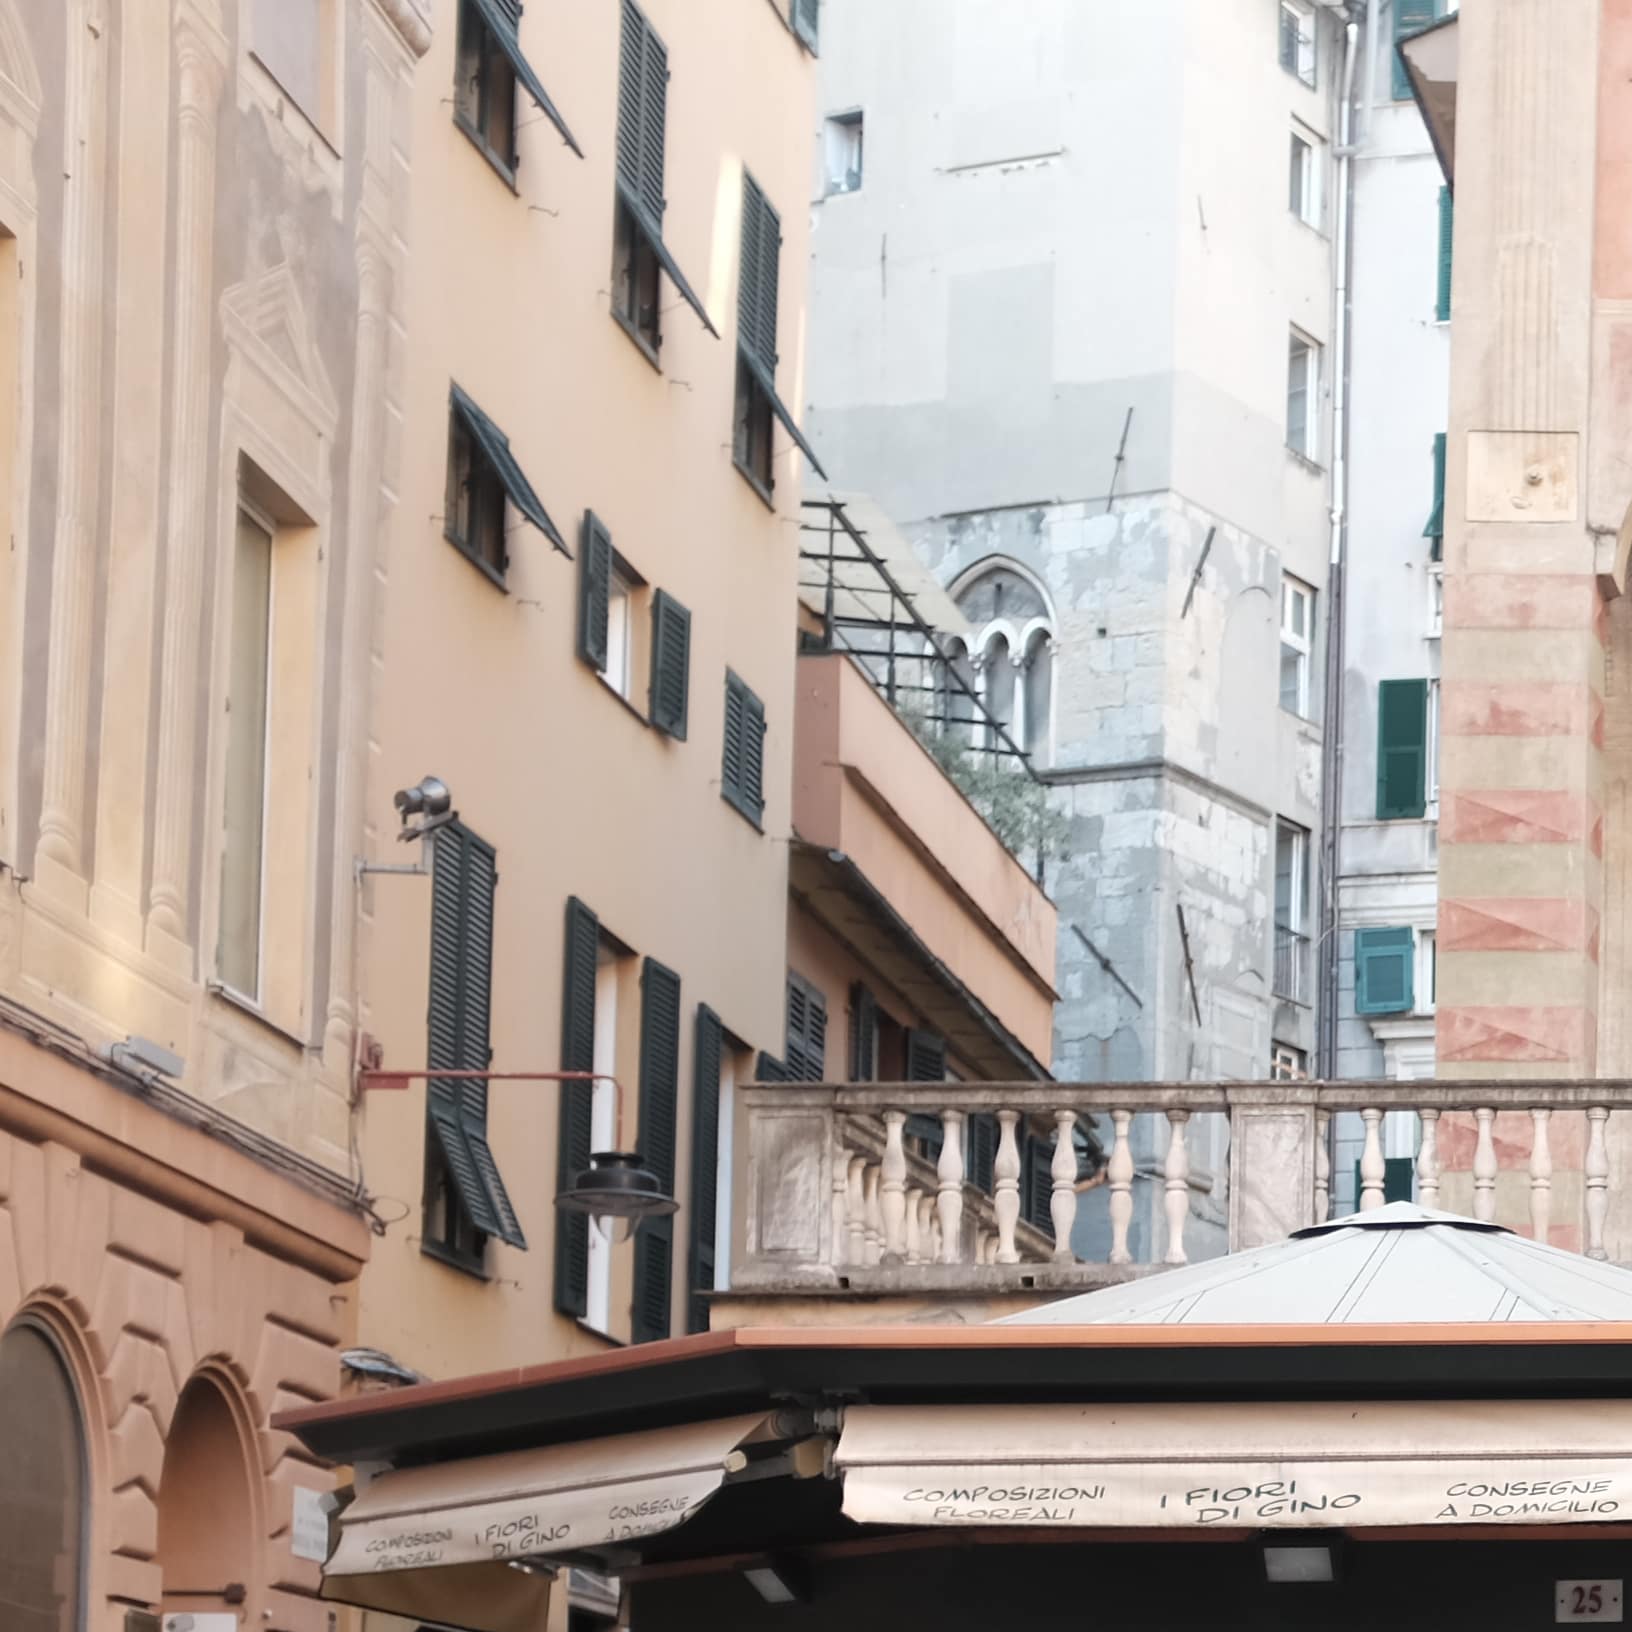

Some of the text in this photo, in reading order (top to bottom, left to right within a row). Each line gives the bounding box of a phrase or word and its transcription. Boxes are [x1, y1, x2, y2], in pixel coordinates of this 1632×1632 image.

[903, 1485, 1105, 1503] COMPOSIZIONI
[1160, 1480, 1296, 1509] I FIORI
[1446, 1479, 1613, 1497] CONSEGNE
[933, 1505, 1075, 1521] FLOREALI
[1196, 1494, 1362, 1524] DI GINO
[1435, 1499, 1619, 1519] A DOMICILIO
[485, 1513, 538, 1542] FIORI
[492, 1523, 570, 1559] DI GINO
[1572, 1585, 1603, 1614] 25
